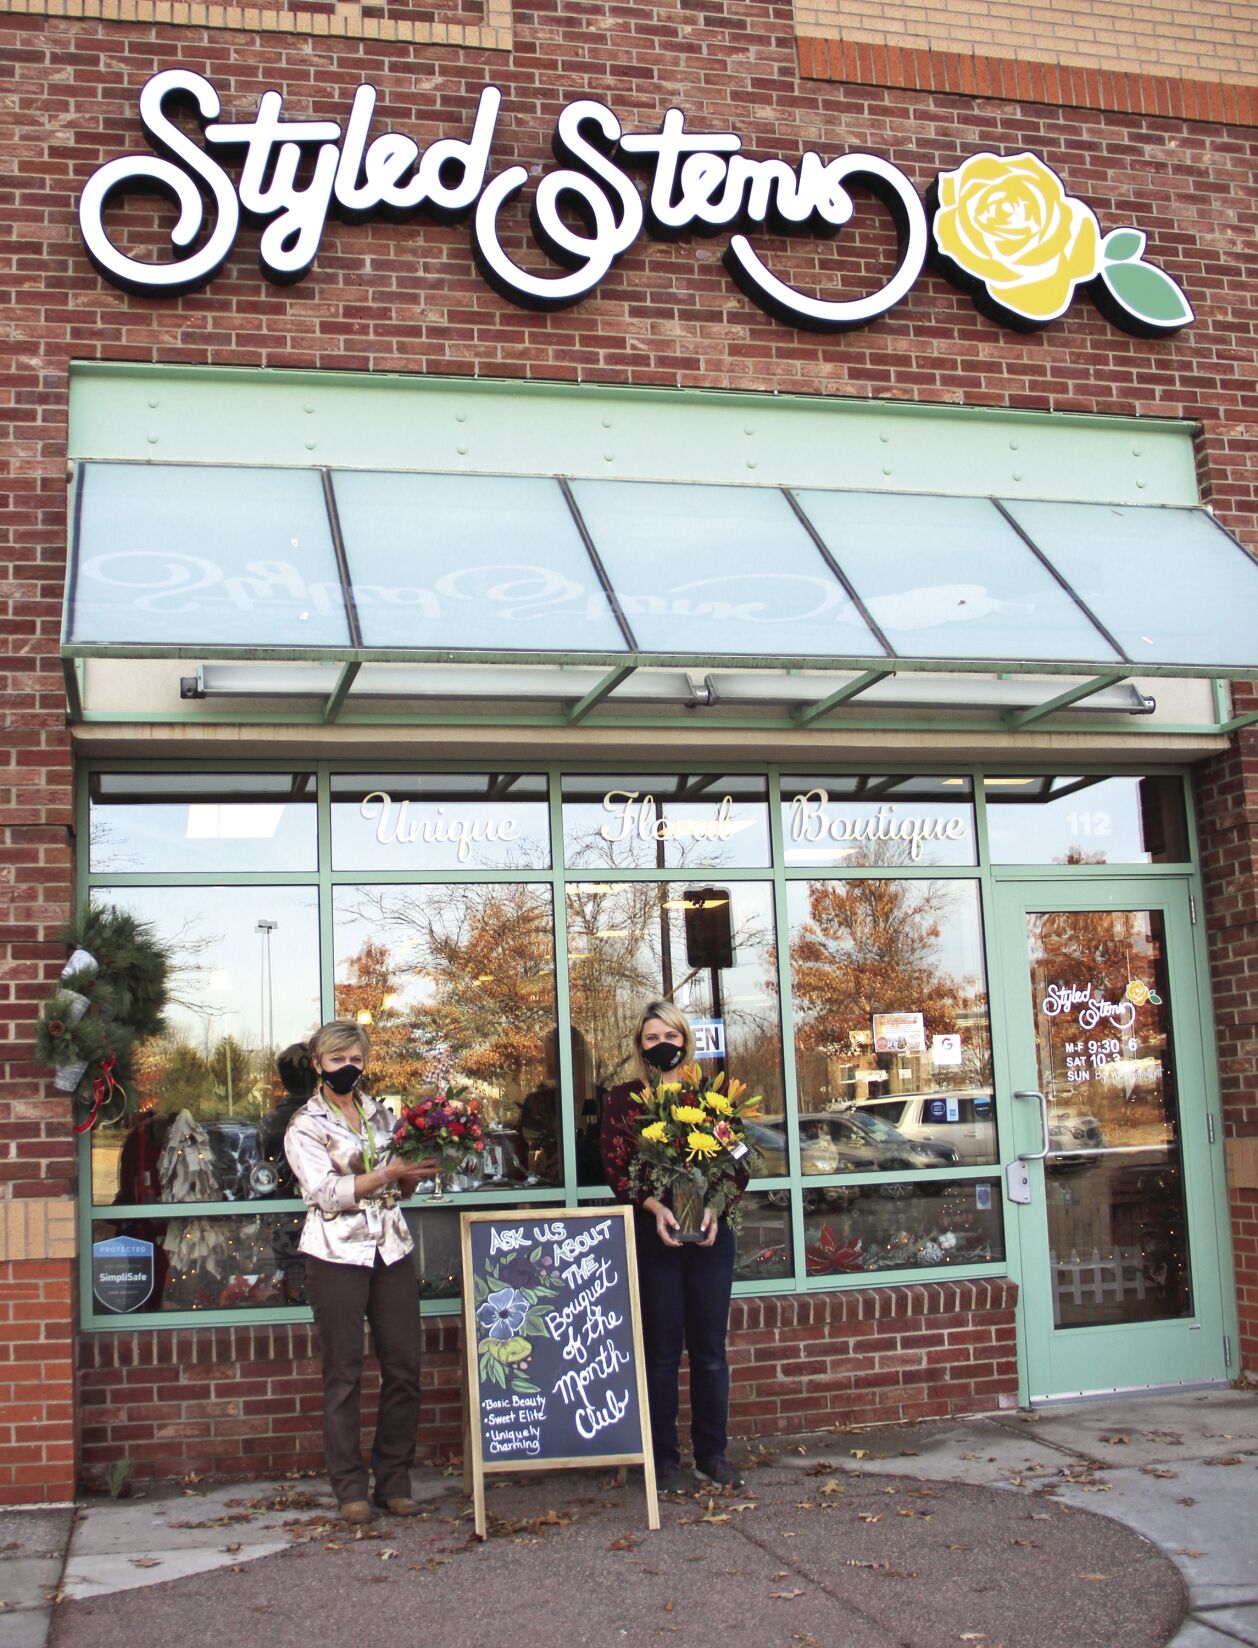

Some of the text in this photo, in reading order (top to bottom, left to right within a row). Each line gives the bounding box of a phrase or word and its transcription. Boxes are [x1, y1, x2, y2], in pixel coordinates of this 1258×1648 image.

[78, 68, 929, 322] Styled Stems
[360, 788, 966, 862] Unique Floral Boutique
[1065, 811, 1111, 836] 112
[1043, 982, 1091, 1016] Styled
[1079, 999, 1135, 1029] Stems
[692, 1026, 720, 1052] EN
[1066, 1056, 1087, 1067] SAT
[1067, 1070, 1090, 1081] SUN
[490, 1226, 532, 1255] ASK
[552, 1219, 612, 1267] ABOUT
[99, 1272, 147, 1283] SimpliSafe
[561, 1253, 600, 1290] THE
[545, 1258, 618, 1341] Bouquet
[562, 1305, 623, 1364] of the
[488, 1409, 547, 1425] Sweet Elite
[512, 1394, 546, 1413] Beauty
[575, 1389, 629, 1439] Club
[489, 1439, 541, 1455] Charming
[490, 1424, 540, 1444] Uniquely
